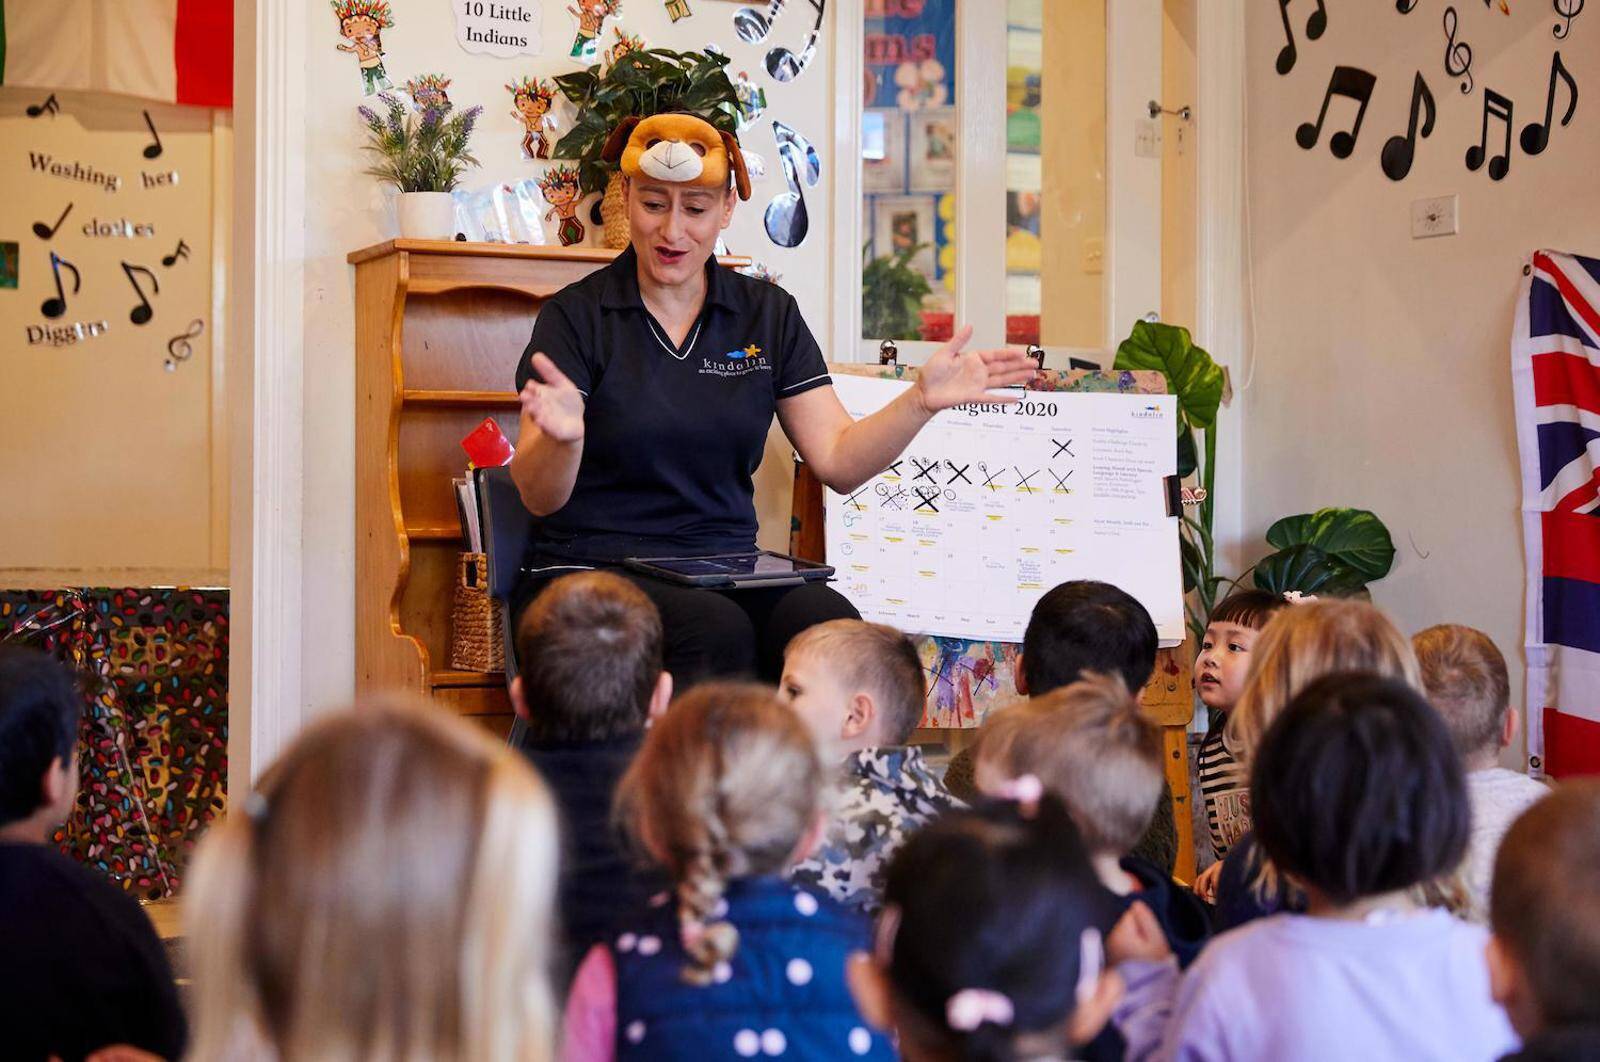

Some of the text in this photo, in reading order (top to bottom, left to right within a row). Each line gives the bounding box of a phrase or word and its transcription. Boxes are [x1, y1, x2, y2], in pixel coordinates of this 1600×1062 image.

[464, 1, 532, 22] 10 Little
[466, 26, 528, 47] Indians
[29, 151, 118, 191] Washing
[703, 357, 767, 371] kindalin
[951, 401, 1058, 417] ugust 2020
